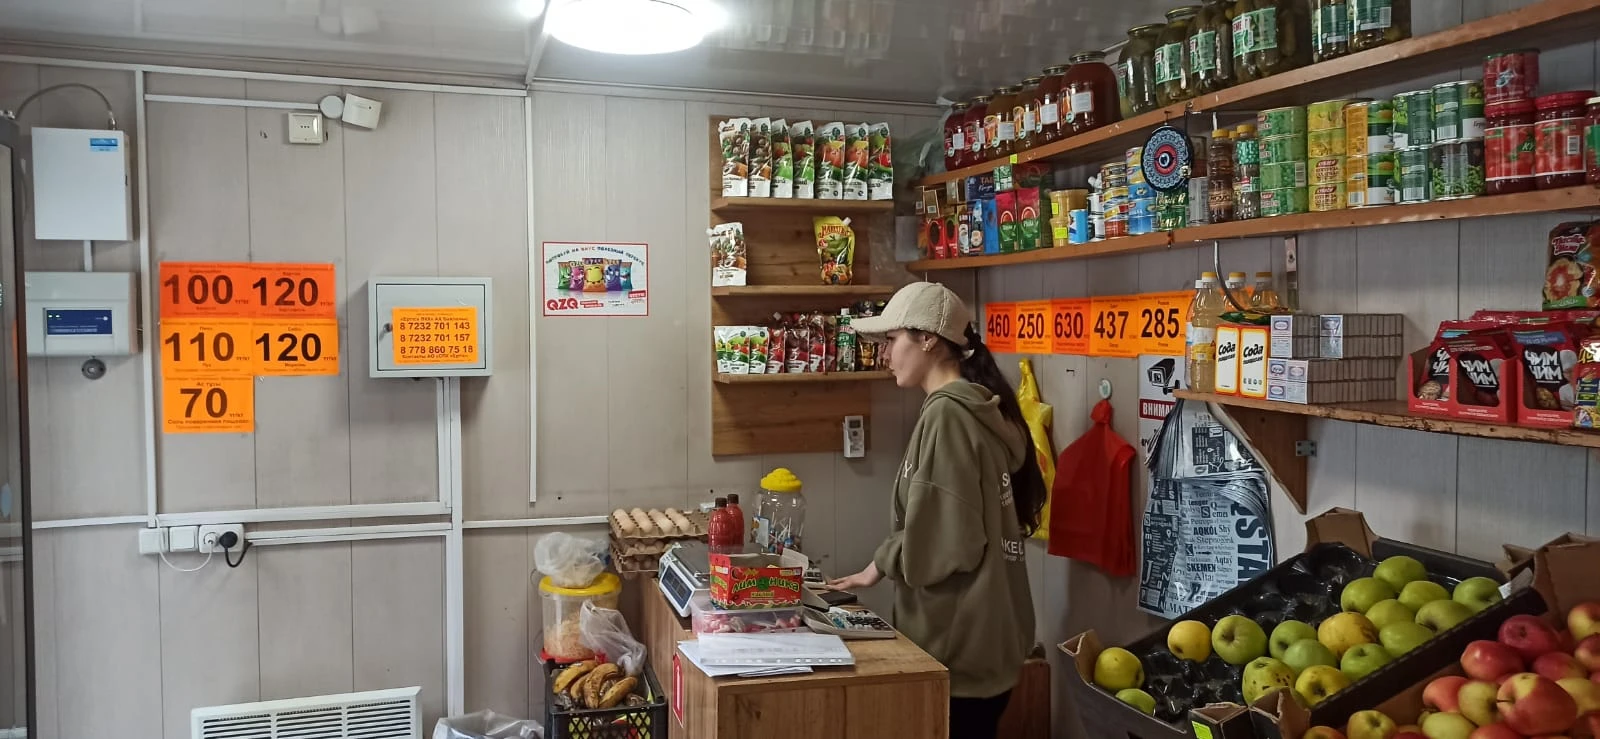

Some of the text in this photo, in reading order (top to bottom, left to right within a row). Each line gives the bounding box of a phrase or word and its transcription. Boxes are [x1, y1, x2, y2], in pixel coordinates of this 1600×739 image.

[164, 274, 233, 305] 100
[252, 277, 319, 307] 120
[546, 297, 579, 311] QZQ
[399, 322, 470, 331] 8 7232 701 143
[988, 313, 1010, 338] 460
[1018, 313, 1045, 339] 250
[1054, 312, 1084, 339] 630
[1094, 311, 1129, 339] 437
[1141, 308, 1179, 338] 285
[165, 332, 234, 362] 110
[255, 333, 321, 361] 120
[400, 333, 470, 343] 8 7232 701 157
[400, 345, 473, 354] 8 778 860 75 18
[180, 388, 228, 418] 70
